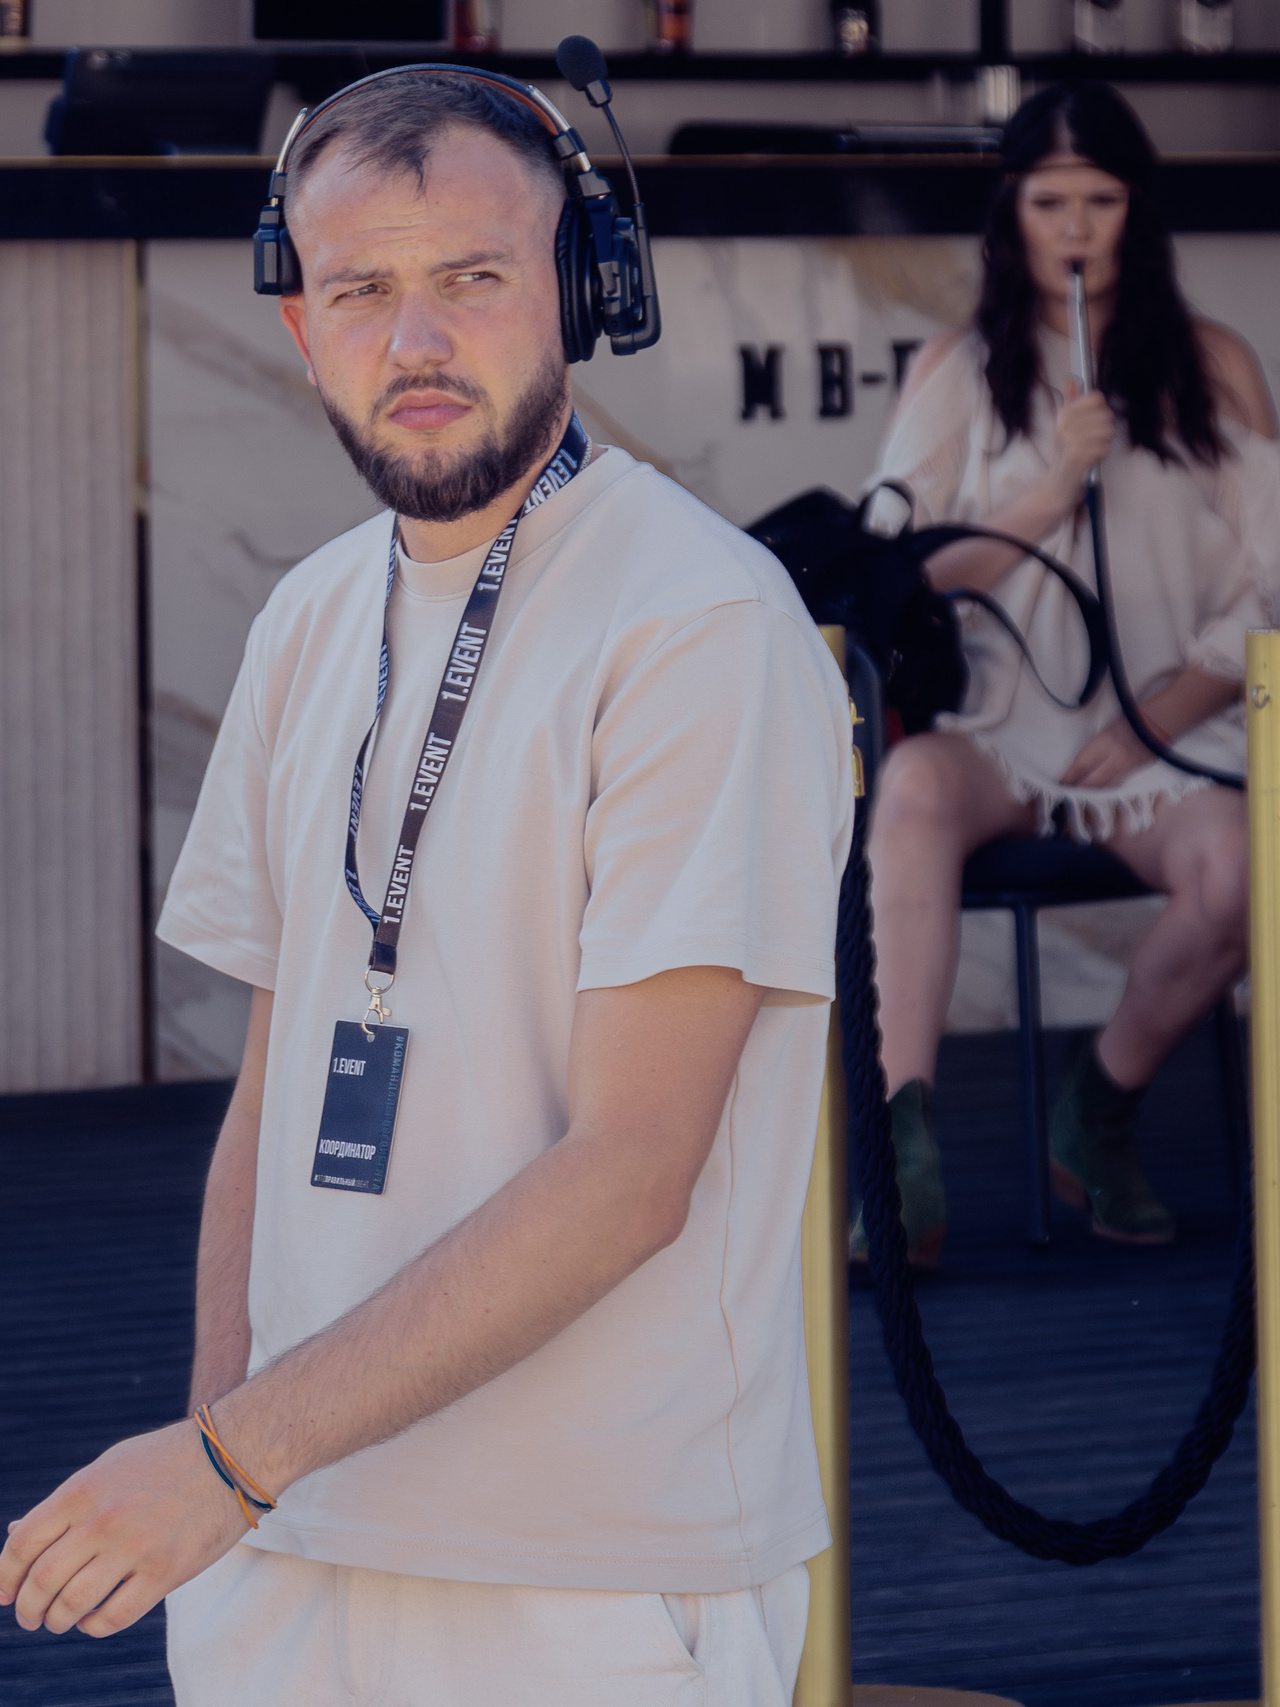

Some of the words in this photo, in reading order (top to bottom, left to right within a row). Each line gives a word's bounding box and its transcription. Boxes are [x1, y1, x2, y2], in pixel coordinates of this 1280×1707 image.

[523, 448, 578, 514] 1.EVENT
[441, 622, 487, 702] 1.EVENT
[409, 732, 452, 812] 1.EVENT
[382, 844, 414, 924] 1.EVENT
[332, 1057, 367, 1076] 1.EVENT
[318, 1138, 377, 1160] КООРДИНАТОР
